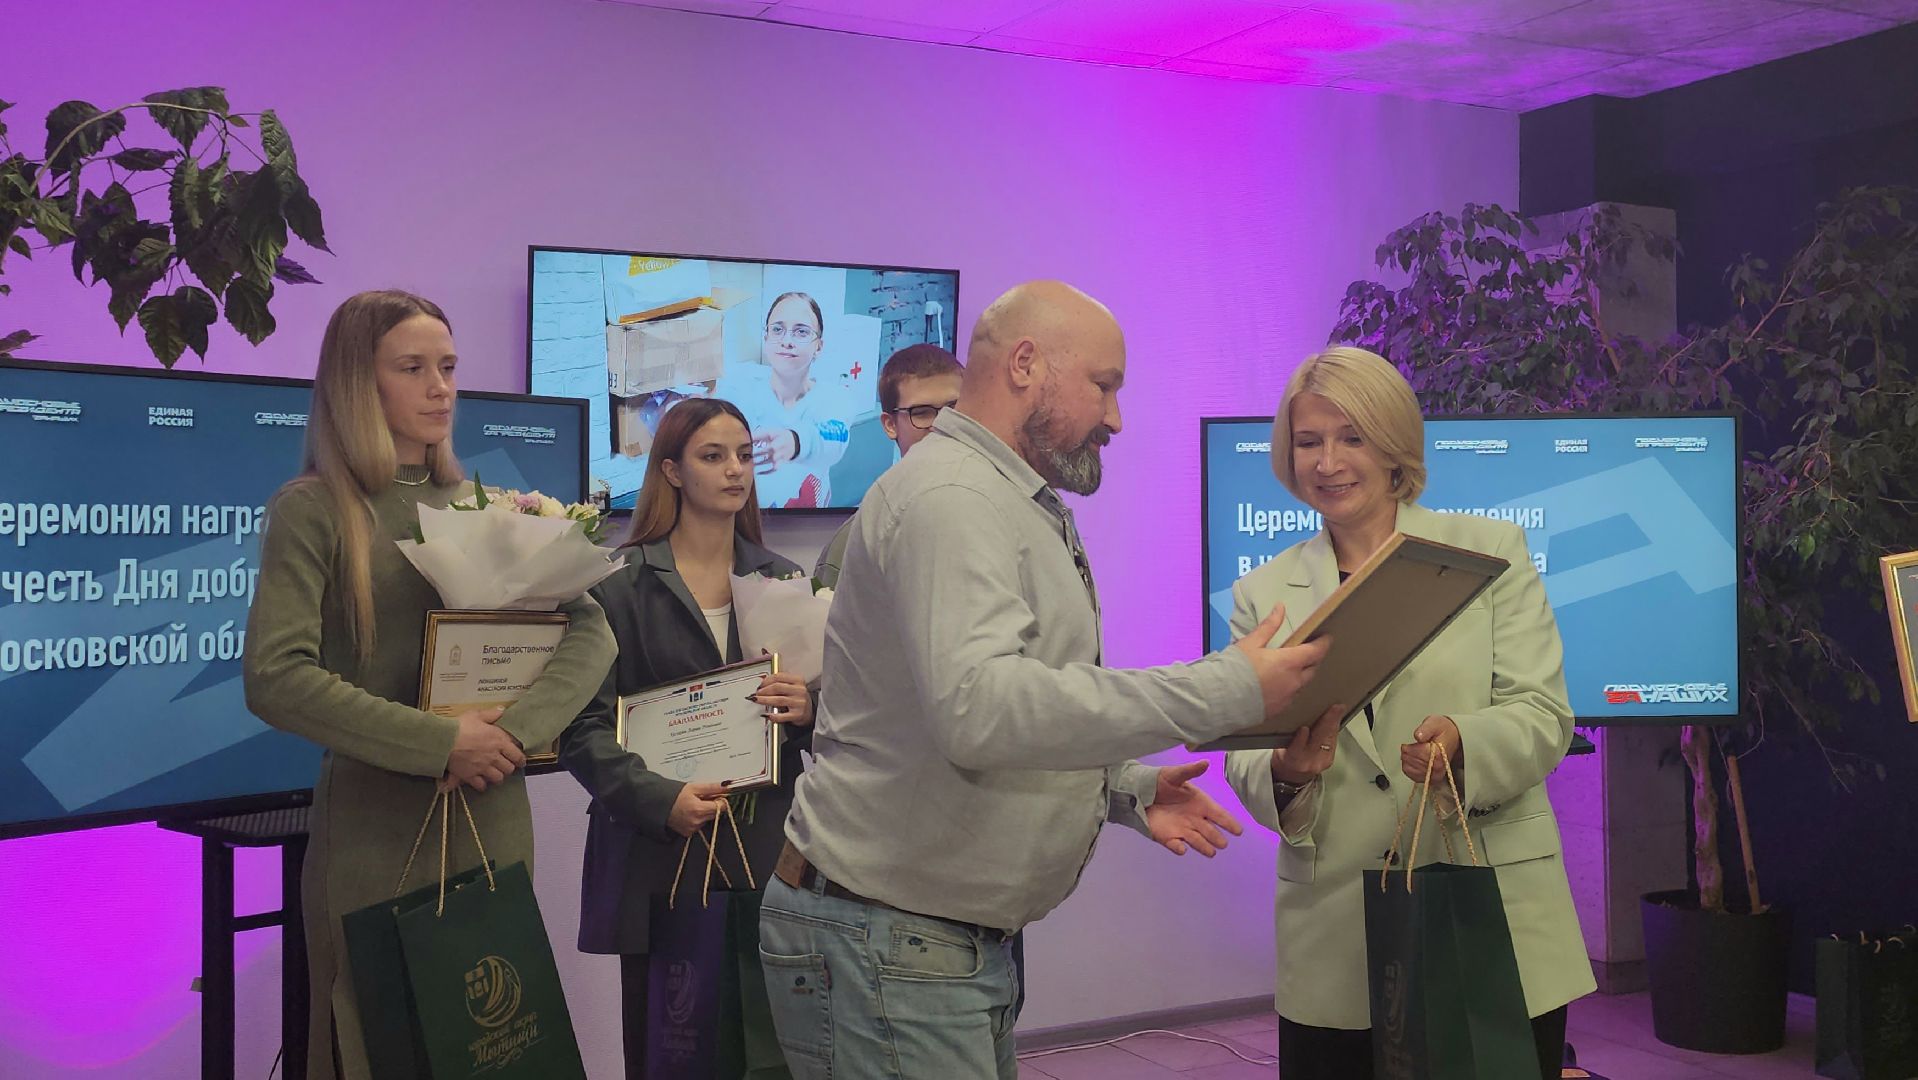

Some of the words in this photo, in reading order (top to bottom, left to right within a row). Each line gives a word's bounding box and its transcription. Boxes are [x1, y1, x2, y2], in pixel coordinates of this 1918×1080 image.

[148, 407, 194, 417] ЕДИНАЯ
[148, 416, 194, 427] РОССИЯ
[0, 502, 171, 546] еремония
[1238, 503, 1324, 539] Церем
[2, 569, 104, 603] честь
[113, 558, 178, 606] Дня
[0, 623, 188, 672] осковской
[482, 644, 555, 656] Благодарственное
